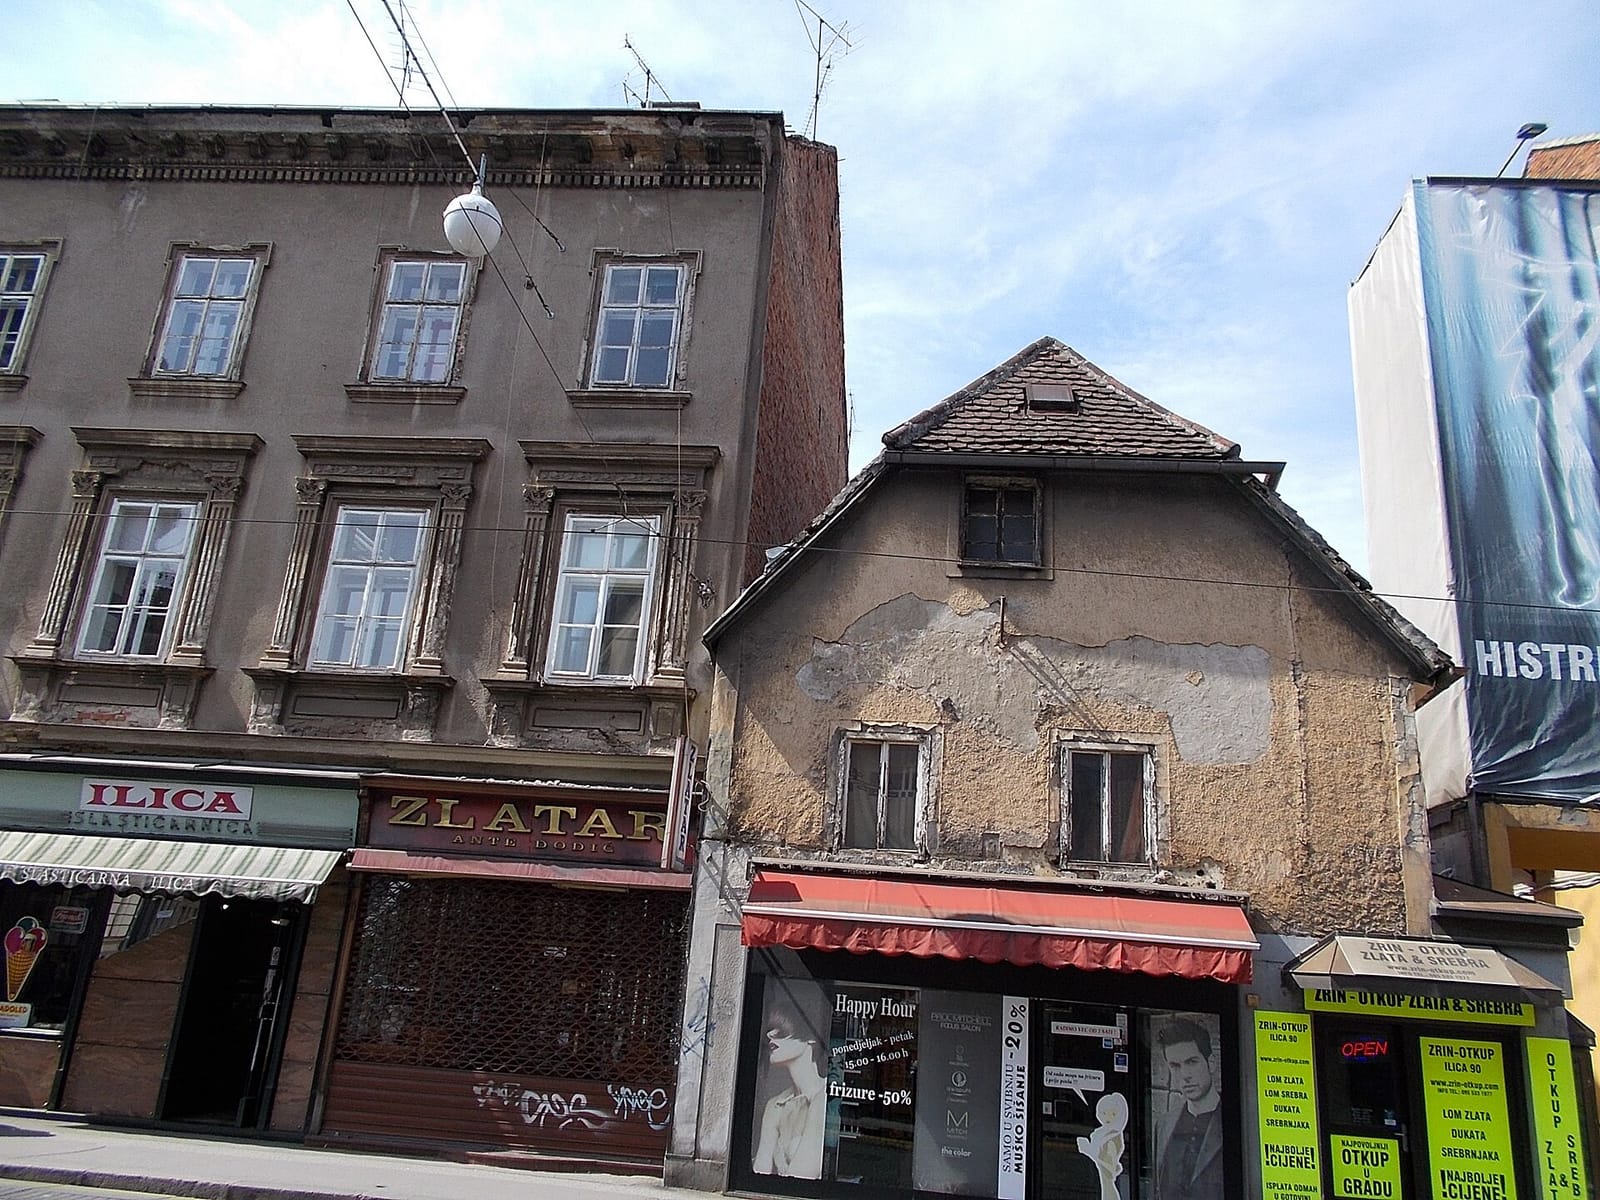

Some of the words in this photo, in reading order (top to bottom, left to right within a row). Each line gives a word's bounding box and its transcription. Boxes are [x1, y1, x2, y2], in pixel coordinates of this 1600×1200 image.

[87, 784, 243, 813] ILICA
[388, 795, 666, 841] ZLATAR
[452, 834, 517, 847] ANTE
[535, 839, 615, 853] DODIĆ
[22, 867, 130, 886] SLASTICARNA
[150, 876, 194, 890] ILICA
[1367, 941, 1404, 953] ZRIN
[1418, 945, 1468, 957] OTKUP
[1360, 951, 1409, 963] ZLATA
[1412, 954, 1424, 965] &
[1427, 956, 1491, 969] SREBRA
[835, 993, 878, 1019] Happy
[880, 997, 916, 1018] Hour
[1314, 989, 1346, 1004] ZRIN
[1359, 991, 1405, 1008] OTKUP
[1408, 994, 1450, 1012] ZLATA
[1453, 998, 1463, 1012] &
[1467, 999, 1523, 1016] SREBRA
[1258, 1020, 1308, 1033] ZRIN-OTKUP
[832, 1036, 883, 1056] ponedjeljak
[890, 1030, 914, 1046] petak
[1269, 1033, 1287, 1042] ILICA
[1288, 1035, 1298, 1043] 90
[1341, 1041, 1388, 1057] OPEN
[1428, 1044, 1495, 1060] ZRIN-OTKUP
[845, 1057, 869, 1070] 15.00
[877, 1050, 901, 1063] 16.00
[901, 1048, 909, 1058] h
[1444, 1061, 1468, 1073] ILICA
[1470, 1063, 1482, 1074] 90
[1267, 1074, 1282, 1083] LOM
[1284, 1076, 1304, 1085] ZLATA
[1430, 1079, 1499, 1091] www.zrin-otkup.com
[829, 1080, 876, 1101] frizure
[878, 1089, 912, 1106] -50%
[1004, 1063, 1014, 1119] SVIBNJU
[1013, 1065, 1026, 1120] ŠIŠANJE
[1264, 1089, 1280, 1098] LOM
[1281, 1090, 1308, 1100] SREBRA
[1273, 1104, 1300, 1114] DUKATA
[1442, 1108, 1462, 1120] LOM
[1464, 1110, 1492, 1122] ZLATA
[1003, 1122, 1013, 1131] U
[1266, 1118, 1310, 1130] SREBRNJAKA
[1451, 1128, 1486, 1141] DUKATA
[1003, 1134, 1012, 1172] SAMO
[1012, 1124, 1024, 1173] MUŠKO
[1270, 1144, 1310, 1155] NAJBOLJE
[1441, 1147, 1500, 1161] SREBRNJAKA
[1270, 1154, 1311, 1169] CIJENE
[1342, 1148, 1389, 1168] OTKUP
[1363, 1167, 1370, 1178] U
[1567, 1135, 1581, 1200] SREB
[1447, 1169, 1500, 1185] NAJBOLJE
[1559, 1173, 1569, 1189] &
[1266, 1182, 1292, 1191] ISPLATA
[1294, 1183, 1318, 1193] ODMAH
[1343, 1177, 1392, 1198] GRADU
[1448, 1182, 1500, 1200] CIJENE
